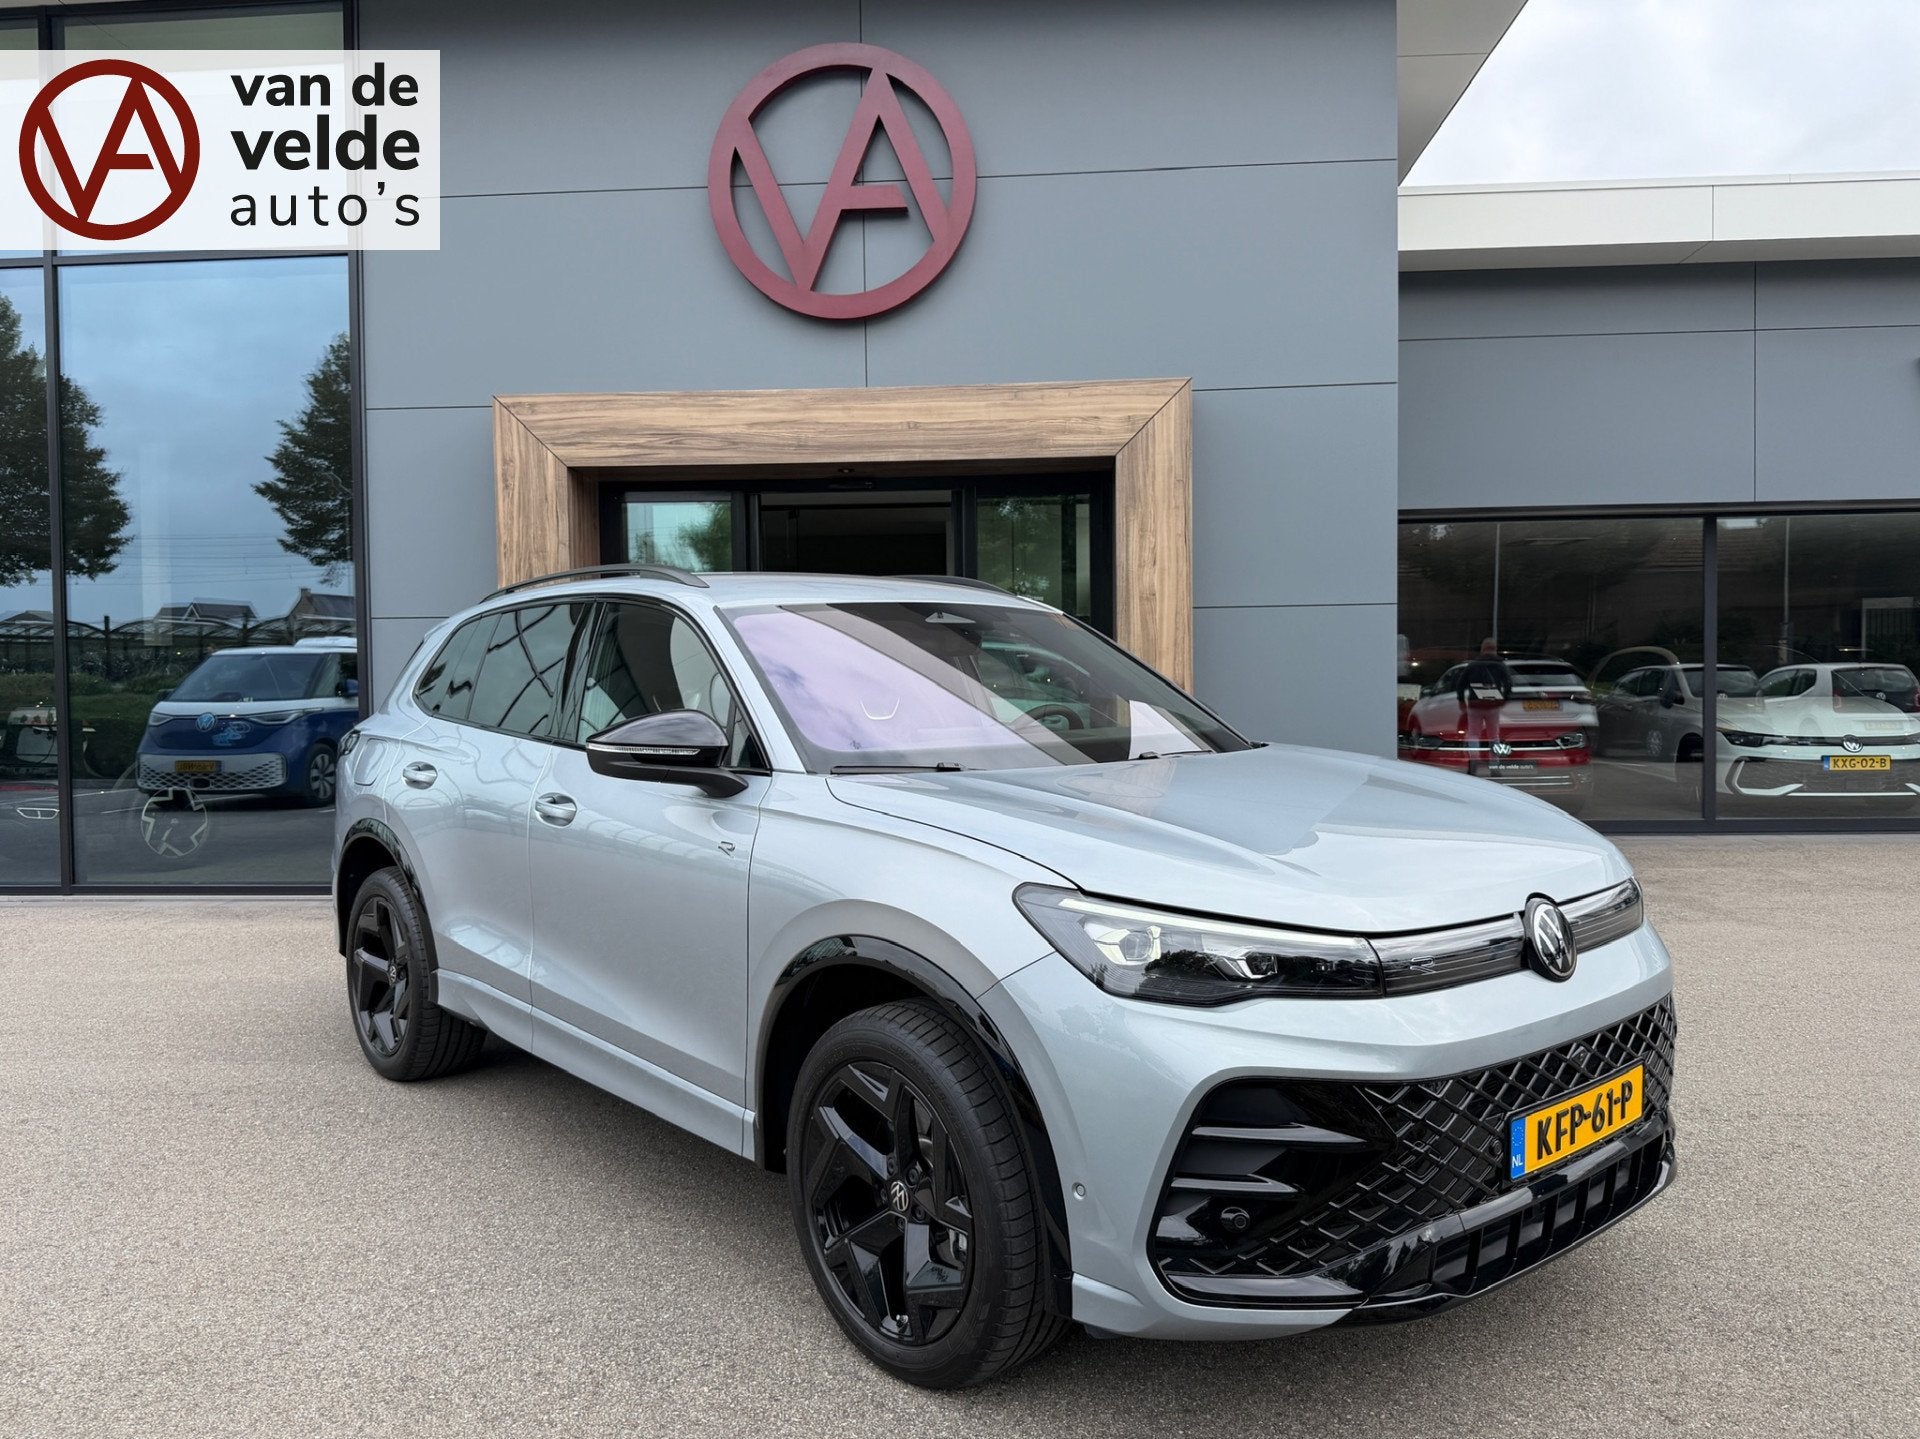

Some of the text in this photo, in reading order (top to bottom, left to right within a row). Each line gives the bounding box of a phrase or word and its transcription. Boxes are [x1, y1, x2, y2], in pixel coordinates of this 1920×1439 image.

[1833, 758, 1887, 768] KXG-02-B
[1537, 1079, 1633, 1161] KFP-61-P
[1512, 1153, 1523, 1169] NL
